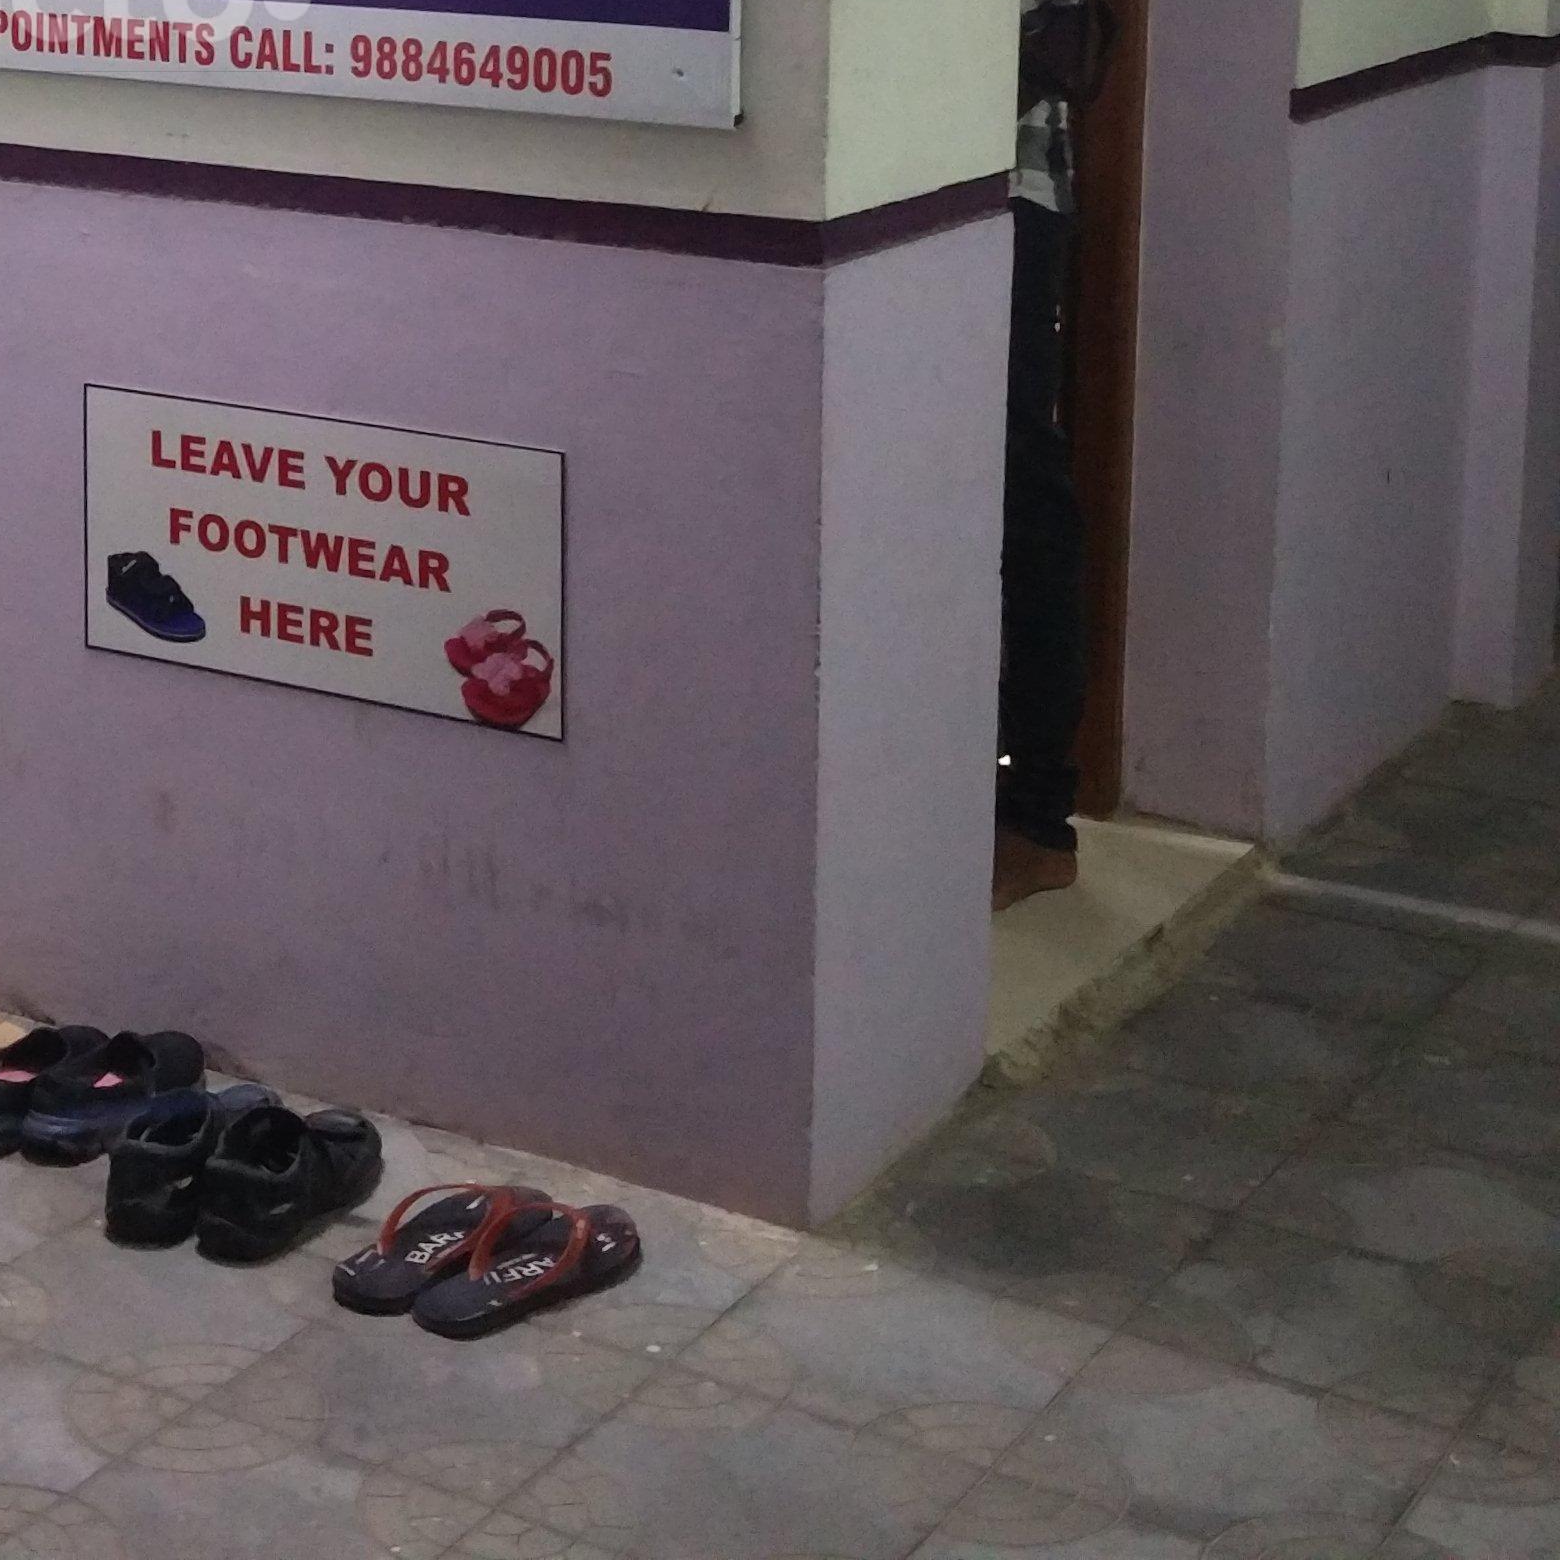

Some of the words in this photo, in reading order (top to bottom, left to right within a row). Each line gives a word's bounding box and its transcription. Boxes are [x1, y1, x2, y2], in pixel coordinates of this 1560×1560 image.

[230, 25, 334, 75] CALL:
[351, 34, 612, 97] 9884649005
[151, 430, 306, 490] LEAVE
[324, 455, 471, 516] YOUR
[169, 508, 452, 592] FOOTWEAR
[240, 596, 374, 657] HERE
